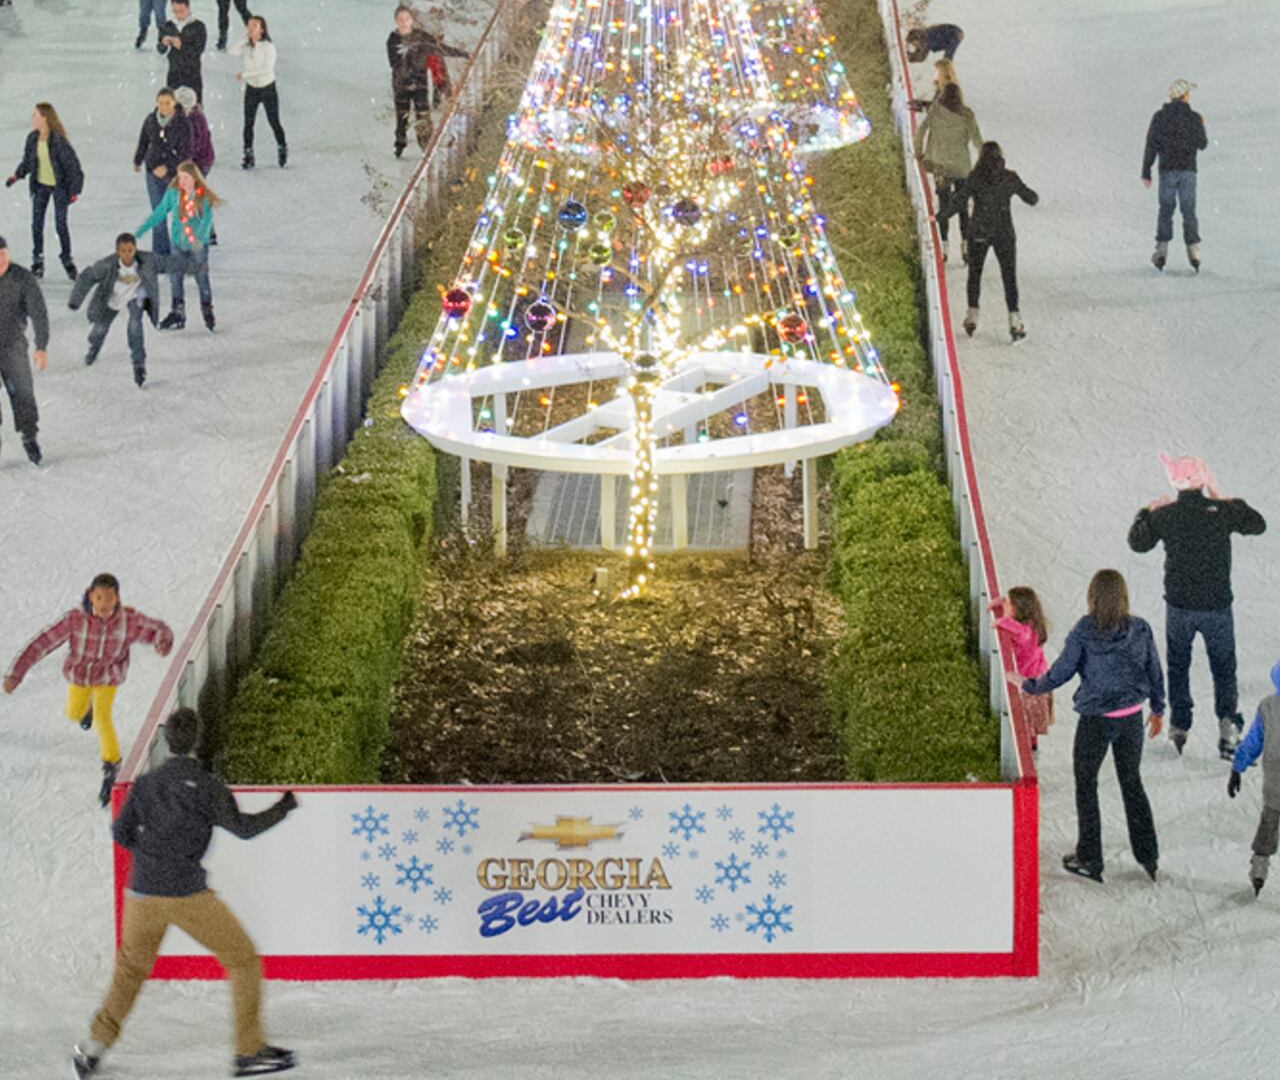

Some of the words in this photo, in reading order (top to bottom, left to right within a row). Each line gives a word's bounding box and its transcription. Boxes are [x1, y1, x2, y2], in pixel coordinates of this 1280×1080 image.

[476, 857, 673, 891] GEORGIA
[477, 886, 585, 938] Best
[586, 893, 652, 908] CHEVY
[587, 908, 674, 925] DEALERS
